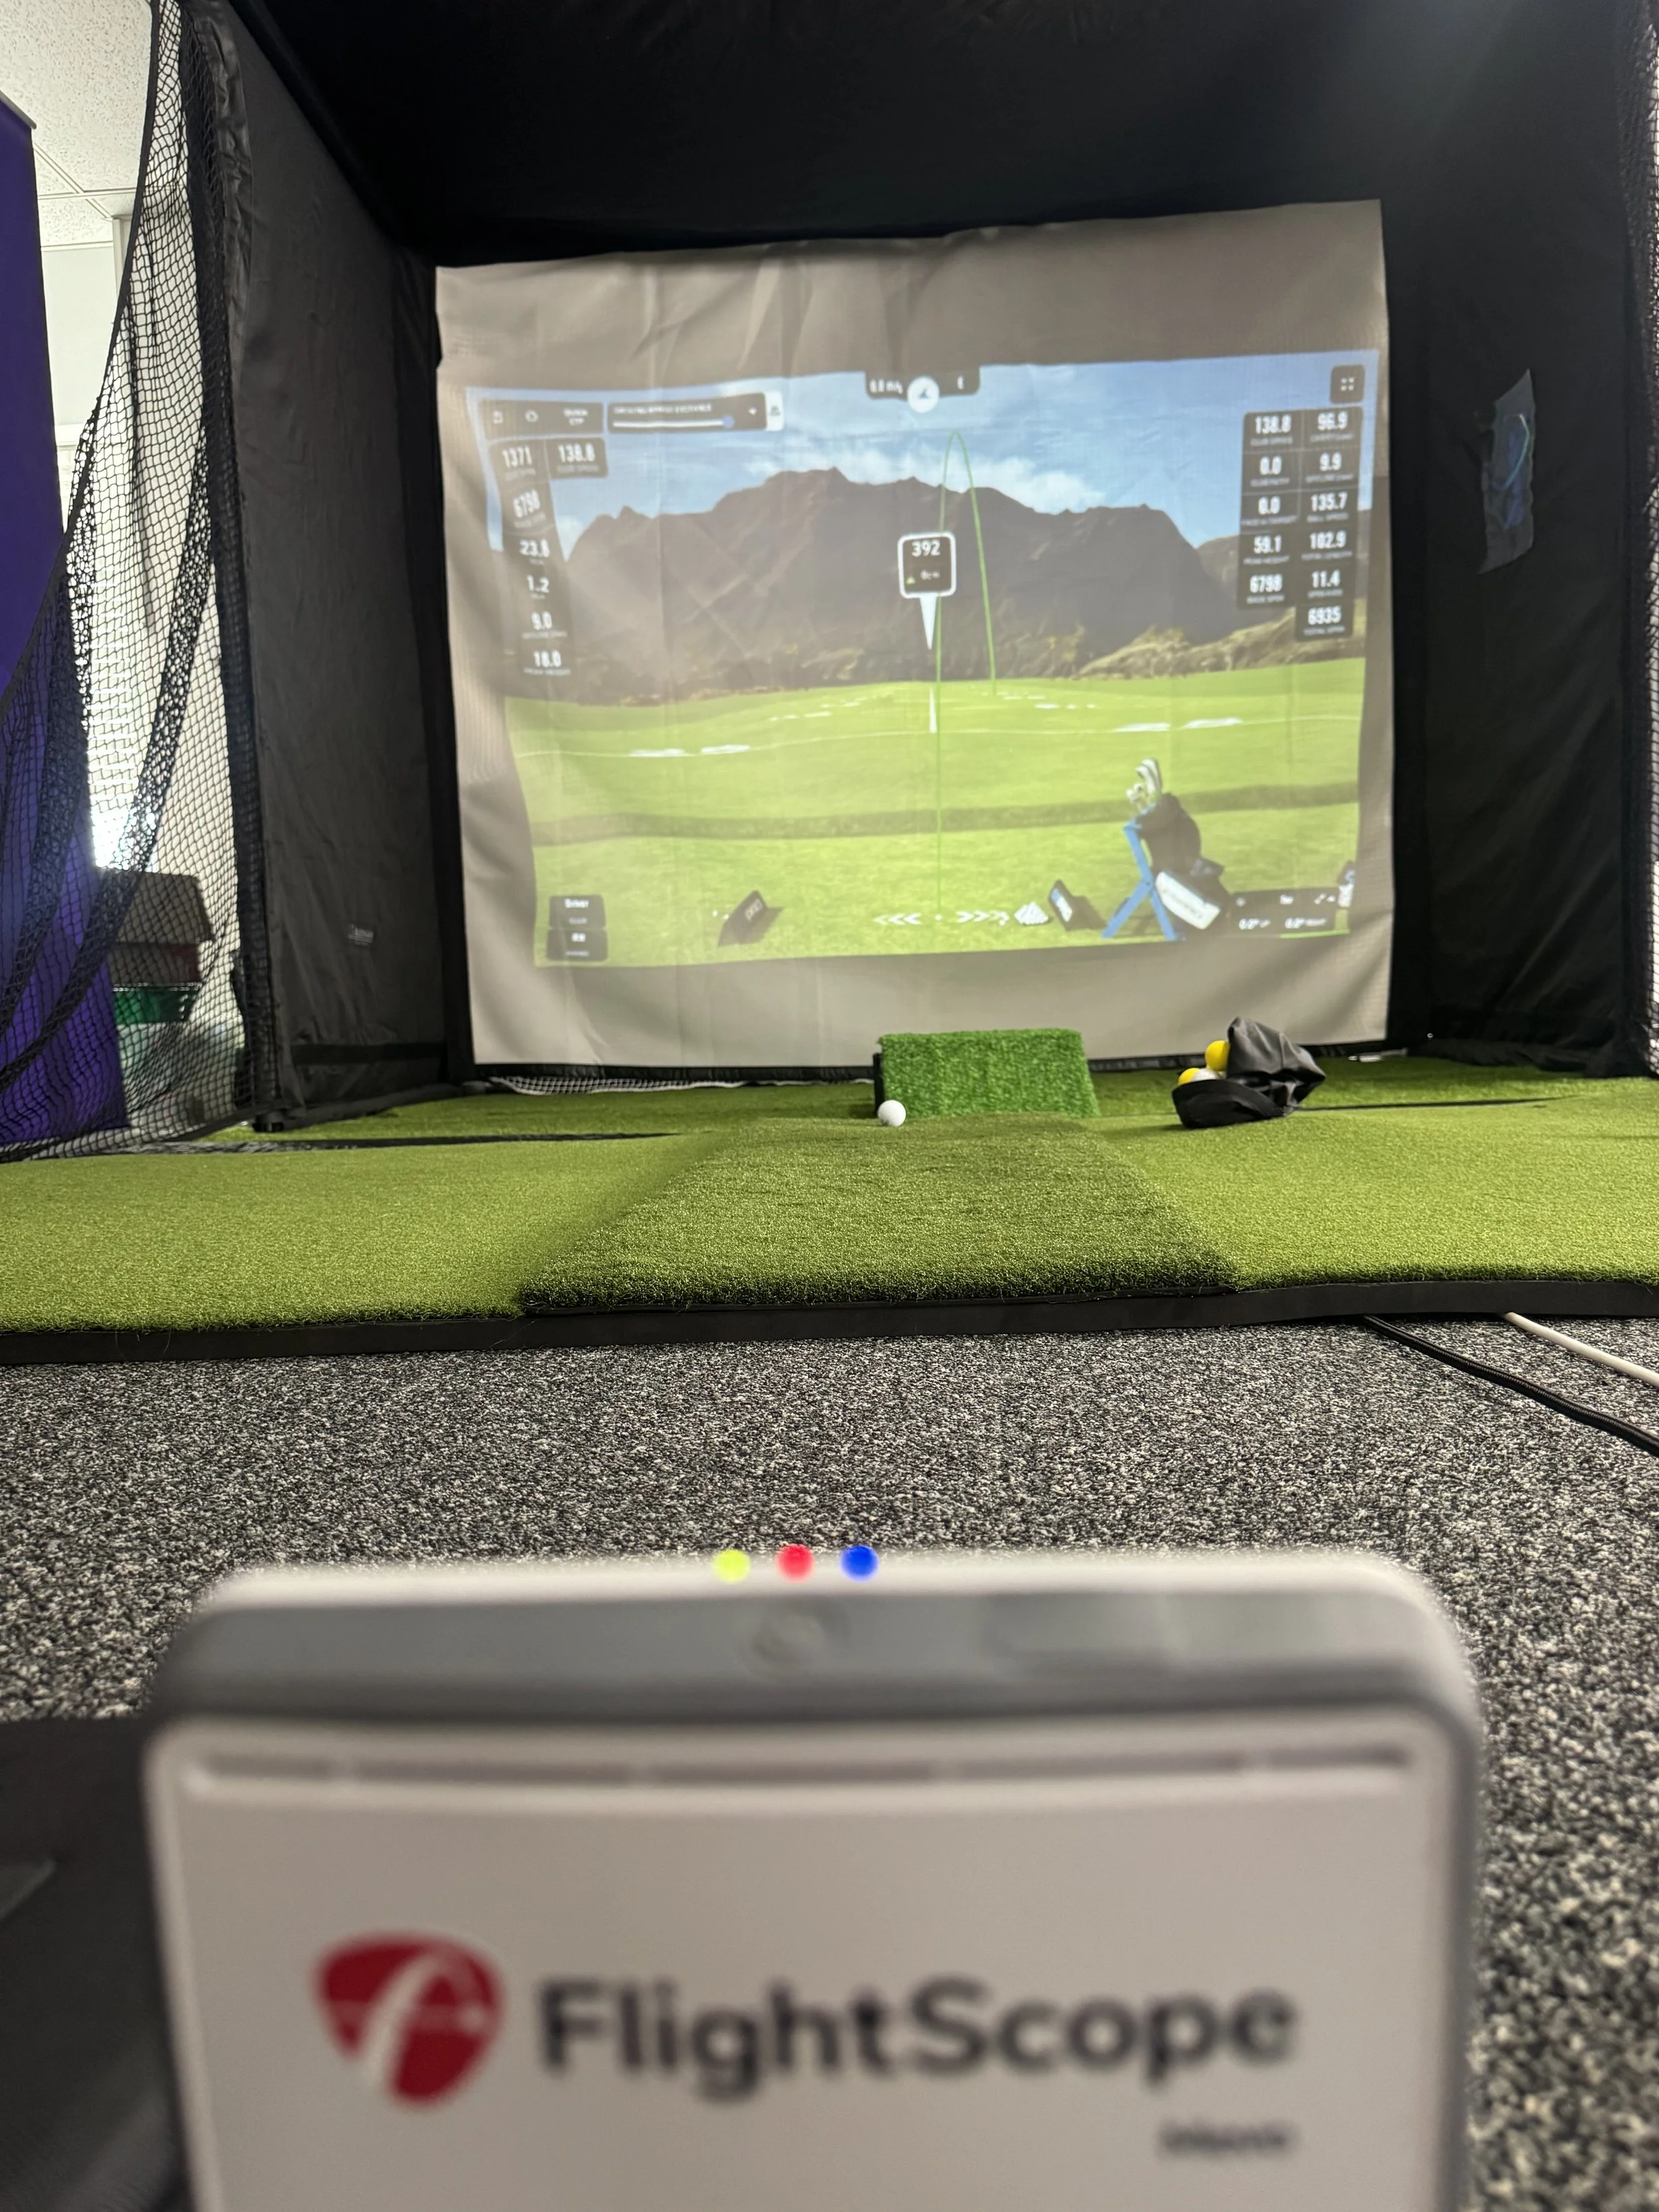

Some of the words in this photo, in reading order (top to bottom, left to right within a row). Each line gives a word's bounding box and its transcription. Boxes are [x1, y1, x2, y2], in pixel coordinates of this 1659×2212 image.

[502, 445, 532, 469] 1371
[1311, 491, 1348, 512] 135.7
[911, 539, 941, 557] 392
[527, 574, 550, 593] 1.2
[1311, 569, 1340, 588] 11.4
[540, 1973, 1296, 2104] FlightScope
